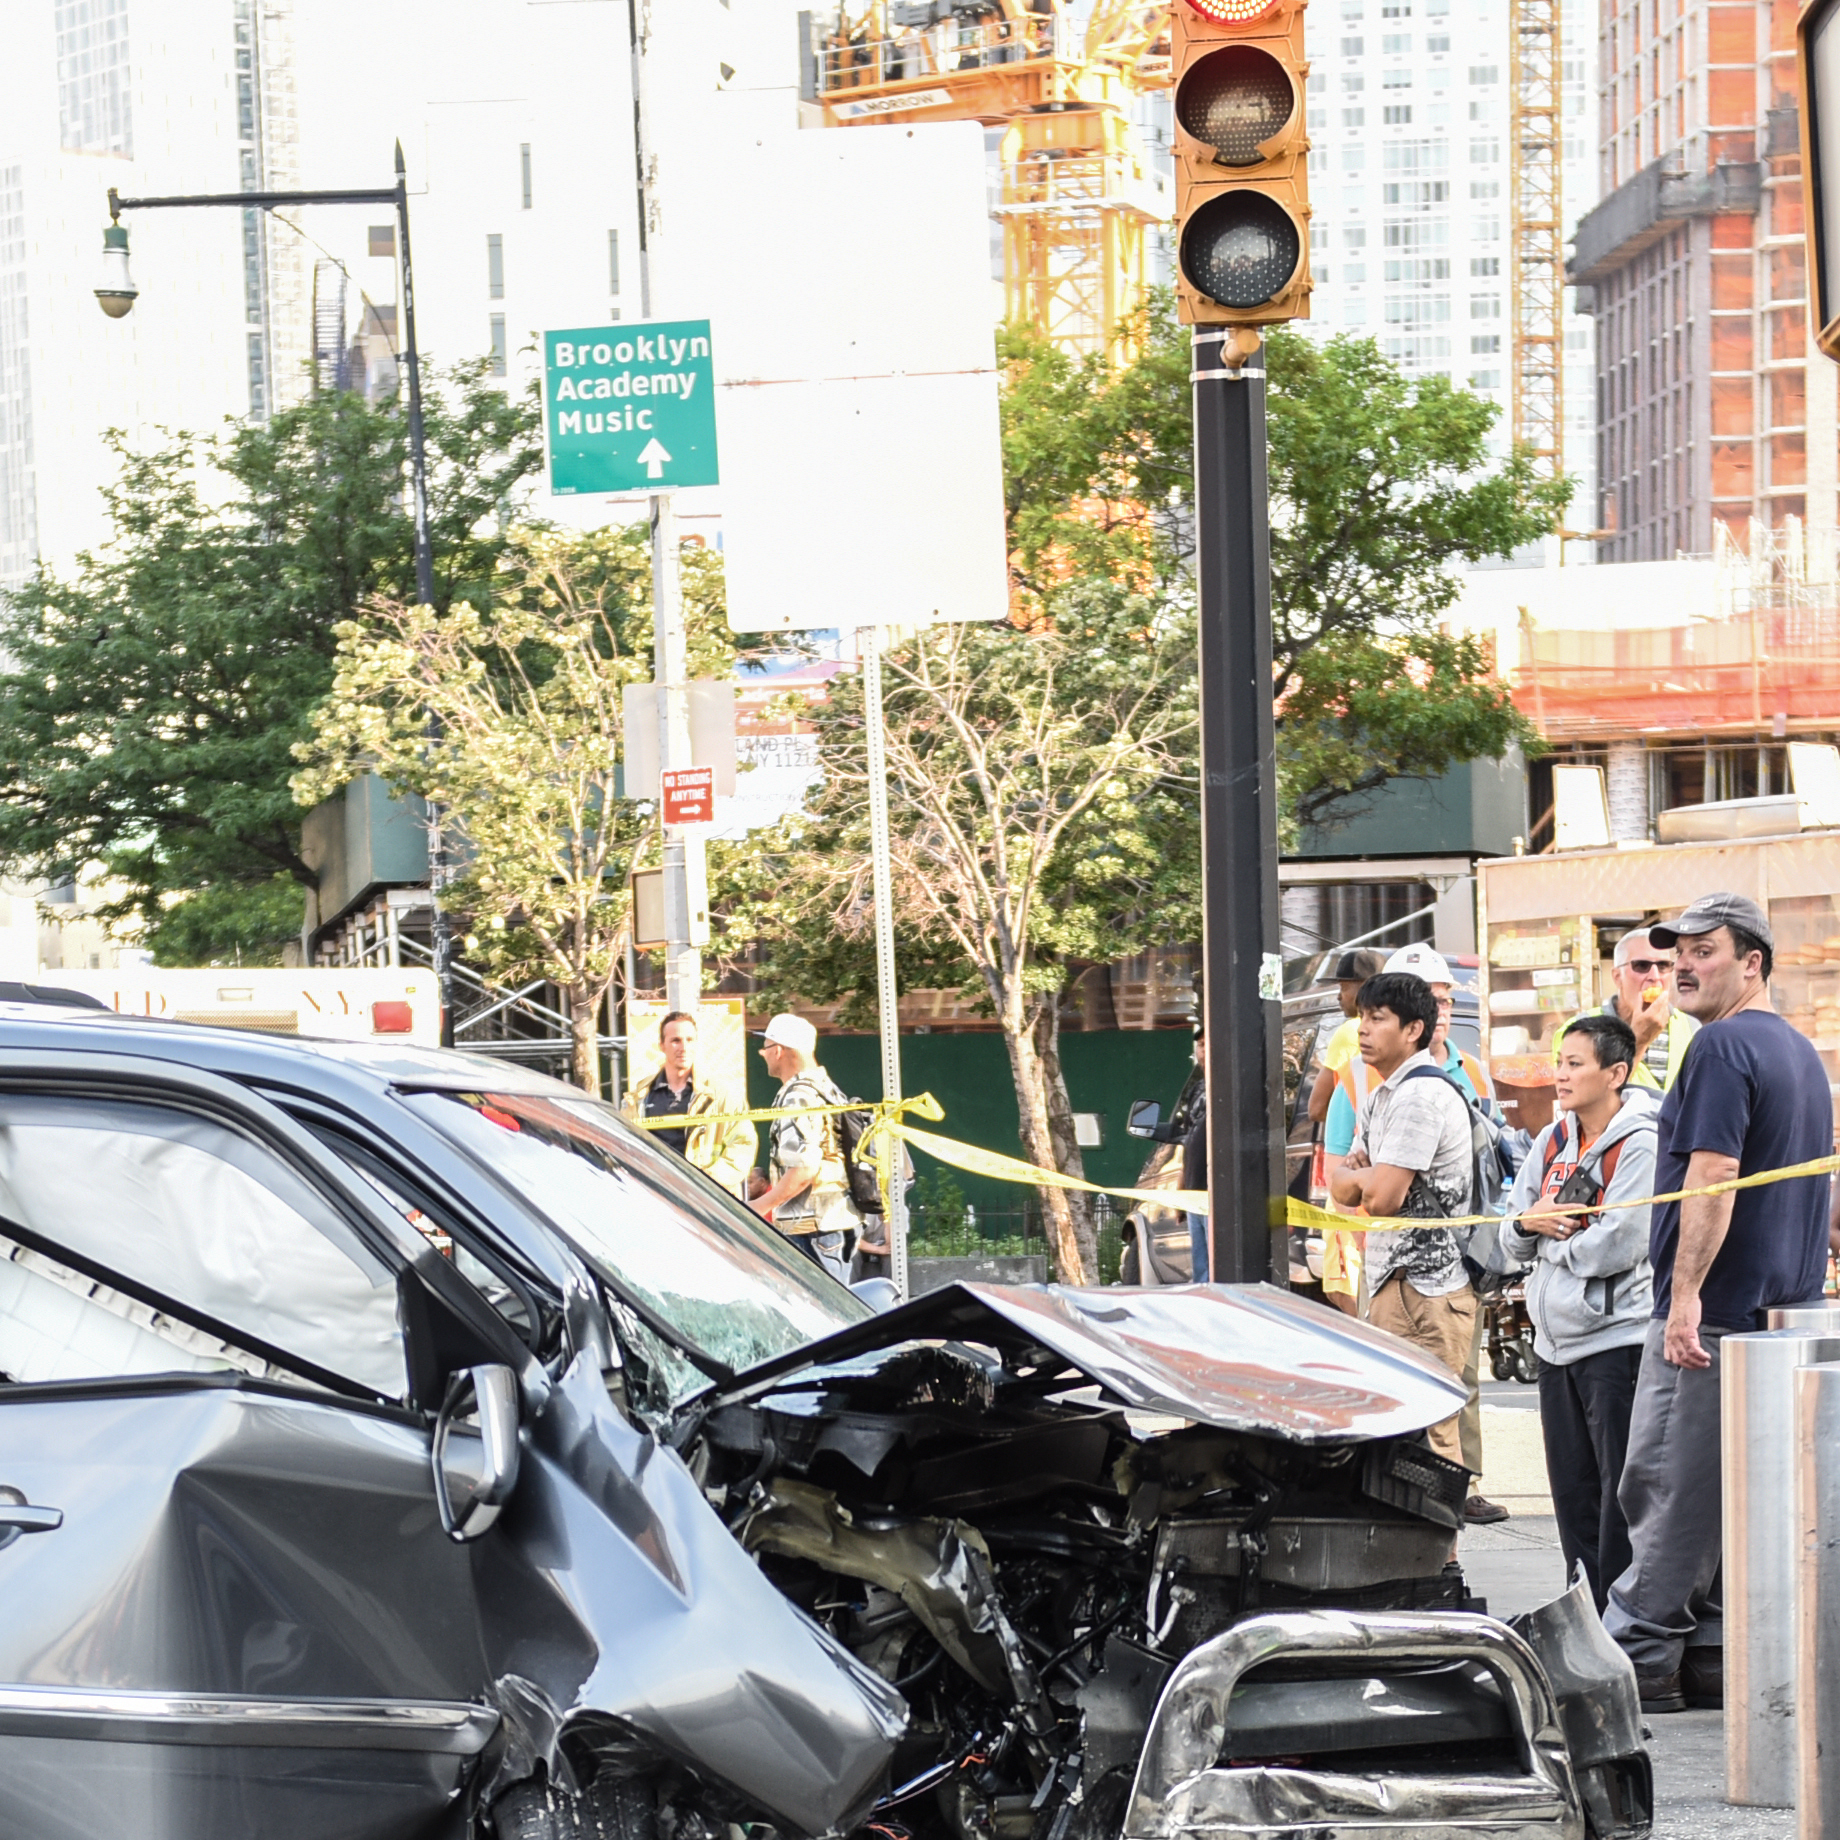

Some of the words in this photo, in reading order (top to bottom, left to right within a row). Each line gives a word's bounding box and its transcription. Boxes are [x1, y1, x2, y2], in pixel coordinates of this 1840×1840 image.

[866, 94, 934, 111] MORROW
[555, 333, 709, 367] Brooklyn
[556, 370, 697, 402] Academy
[558, 404, 653, 435] Music
[735, 737, 778, 752] LAND
[665, 776, 675, 787] NO
[677, 772, 711, 787] STANDING
[670, 788, 706, 802] ANYTIME
